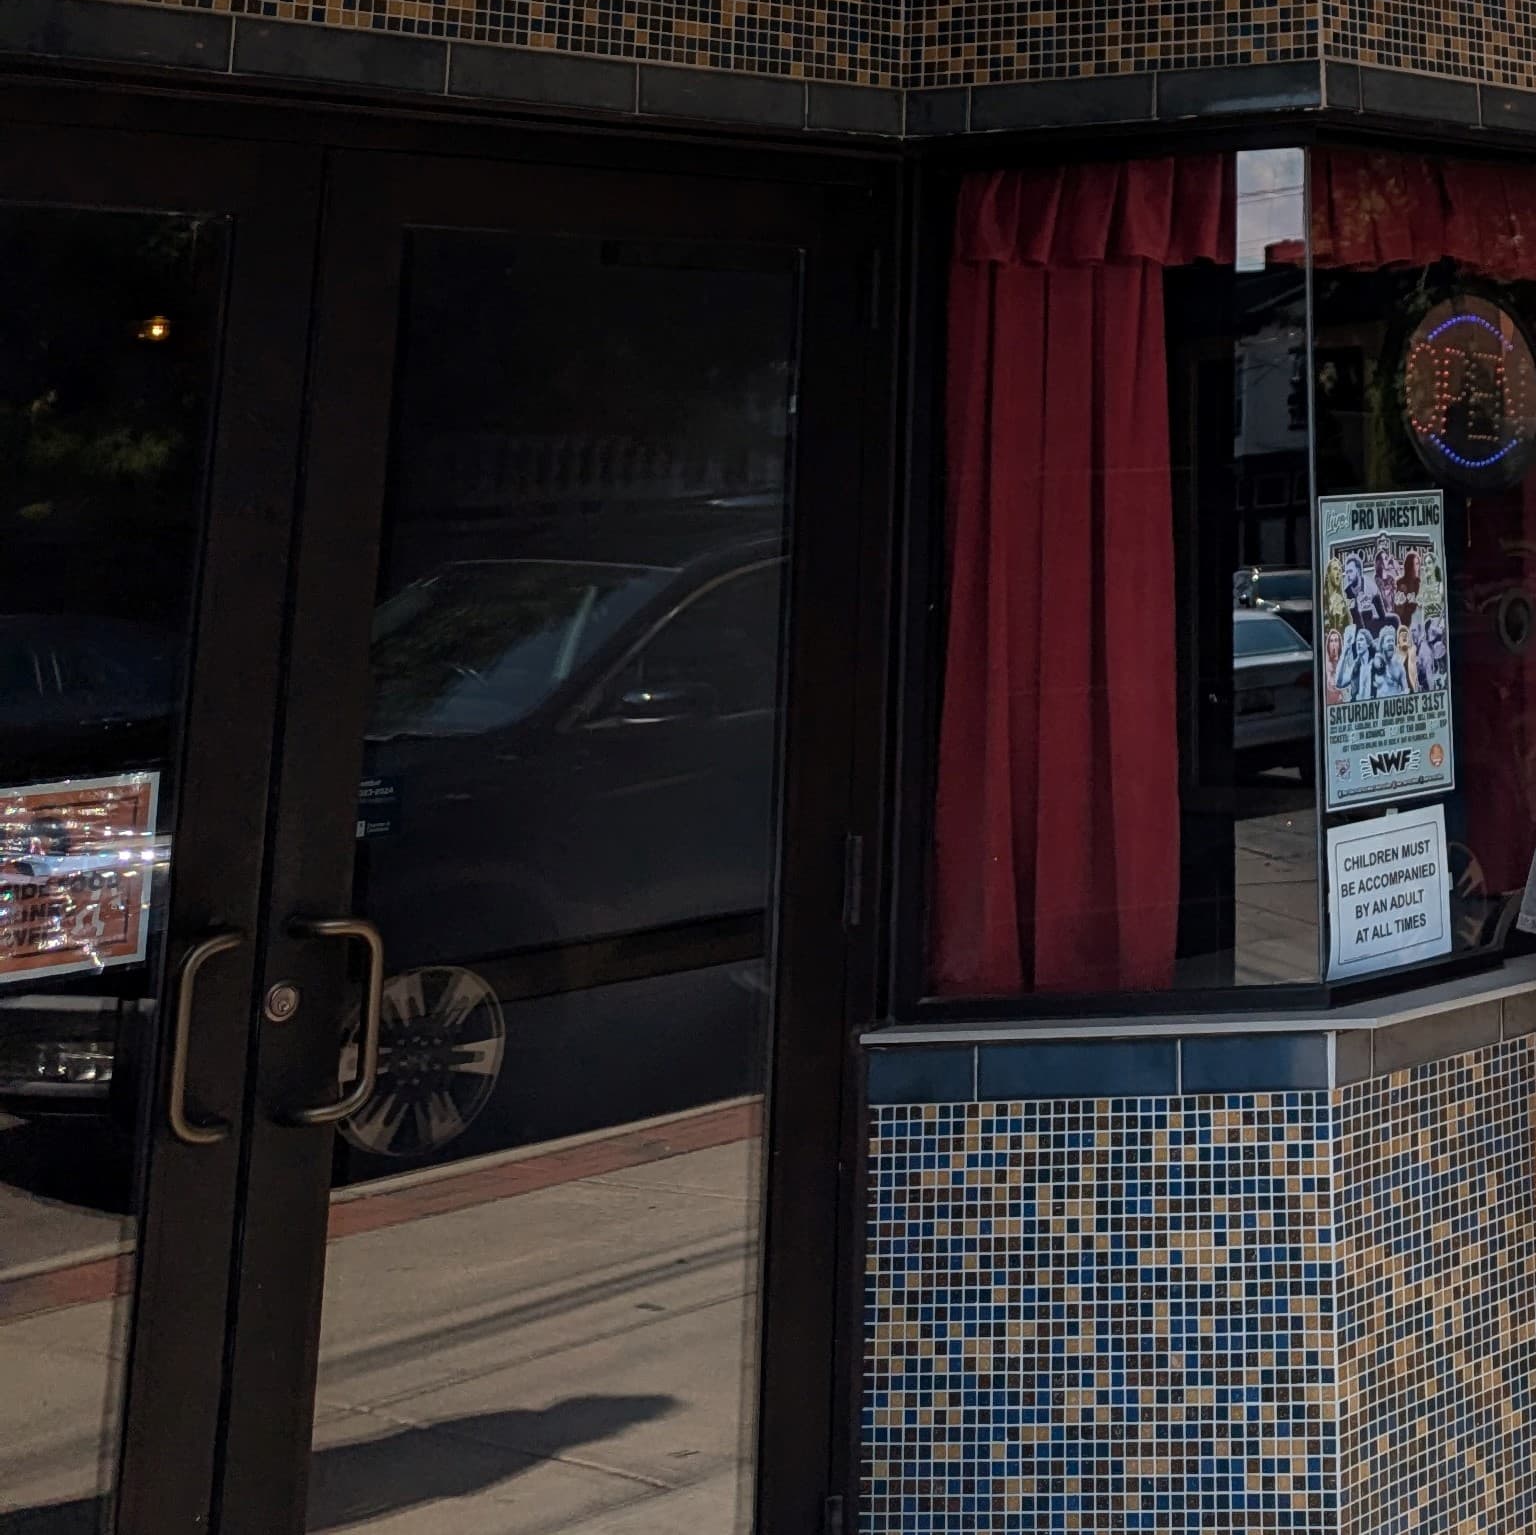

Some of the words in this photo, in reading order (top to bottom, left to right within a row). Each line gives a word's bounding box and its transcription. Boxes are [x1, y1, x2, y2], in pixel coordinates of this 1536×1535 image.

[1351, 508, 1375, 531] PRO
[1377, 504, 1440, 529] WRESTLING
[1330, 701, 1380, 725] SATURDAY
[1383, 696, 1420, 718] AUGUST
[1421, 692, 1446, 713] 31ST
[1369, 749, 1412, 776] NWF
[1344, 847, 1399, 872] CHILDREN
[1402, 839, 1431, 860] MUST
[1341, 881, 1356, 898] BE
[1358, 862, 1436, 894] ACCOMPANIED
[1355, 902, 1370, 919] BY
[1372, 896, 1388, 915] AN
[1390, 889, 1424, 911] ADULT
[1355, 927, 1370, 944] AT
[1372, 922, 1392, 941] ALL
[1395, 913, 1427, 935] TIMES
